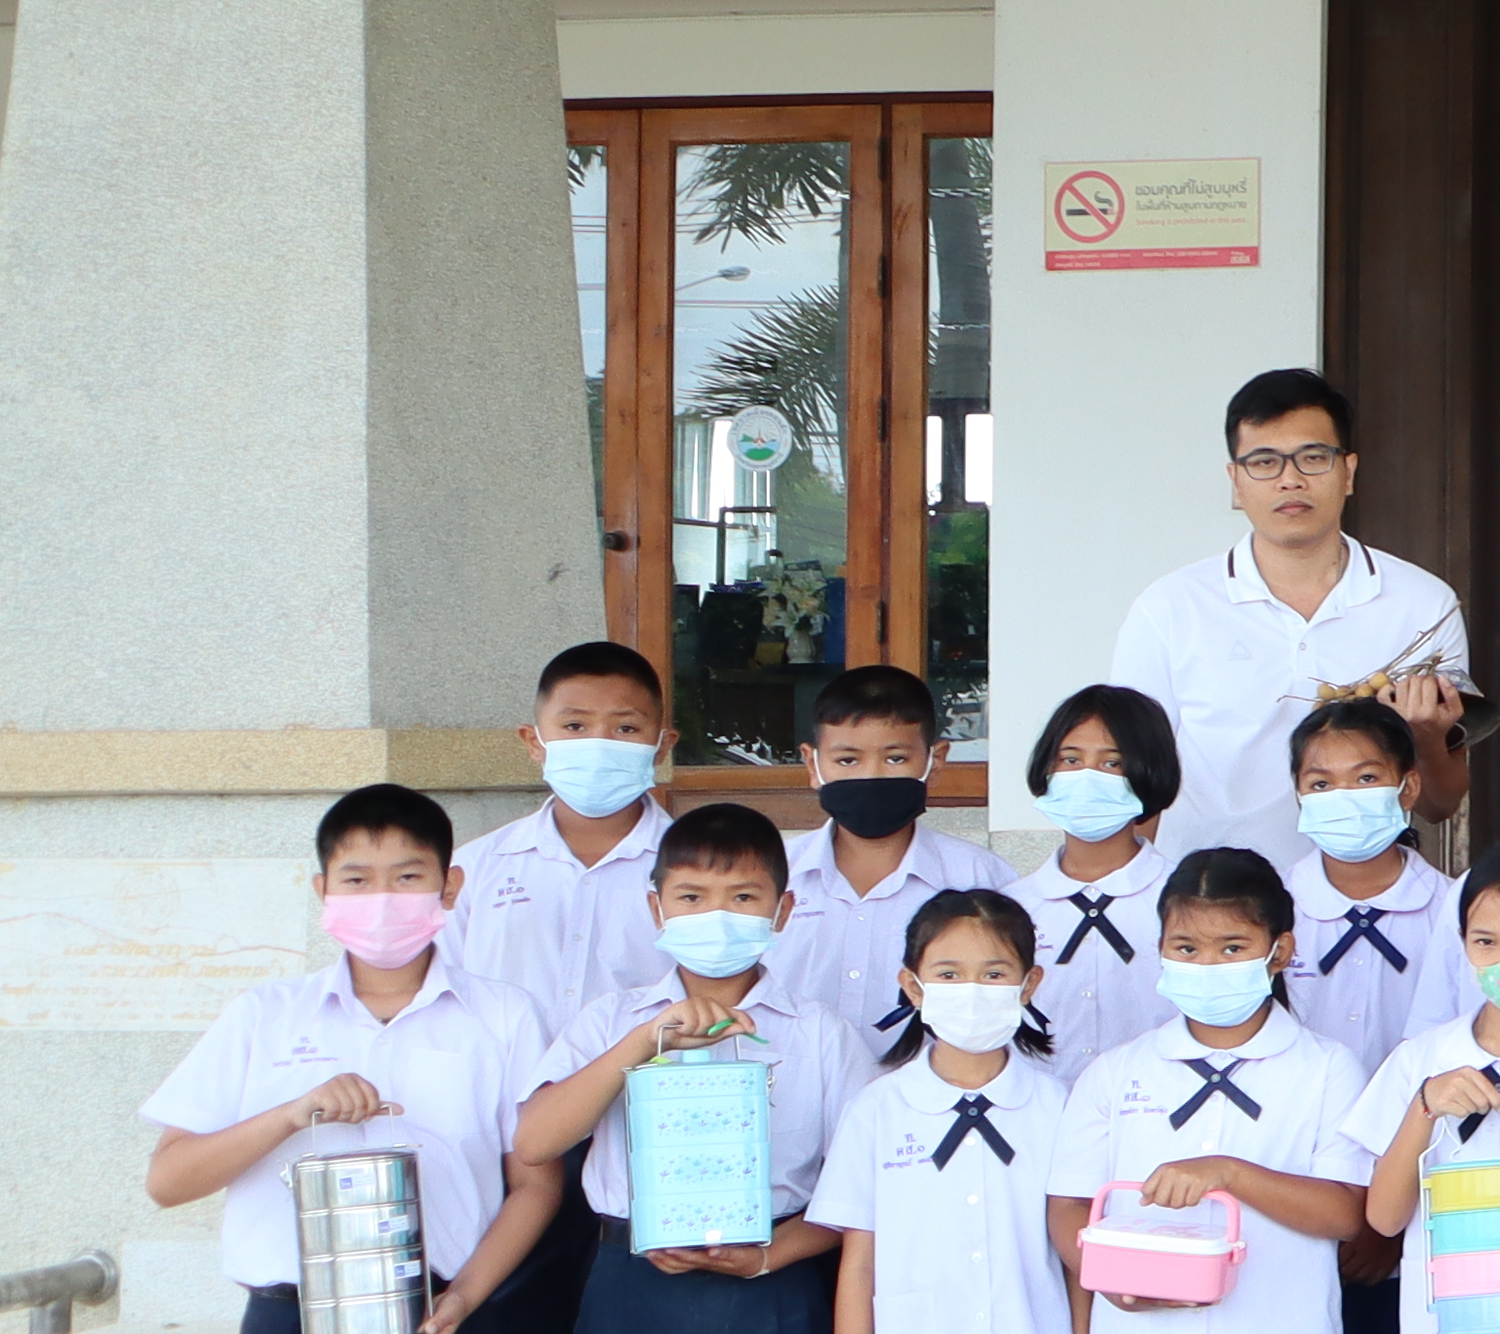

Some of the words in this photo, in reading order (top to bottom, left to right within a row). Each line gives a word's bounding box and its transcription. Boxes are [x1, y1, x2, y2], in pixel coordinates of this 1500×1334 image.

[1135, 177, 1247, 199] ขอบคุณที่ไม่สูบบุหรี่
